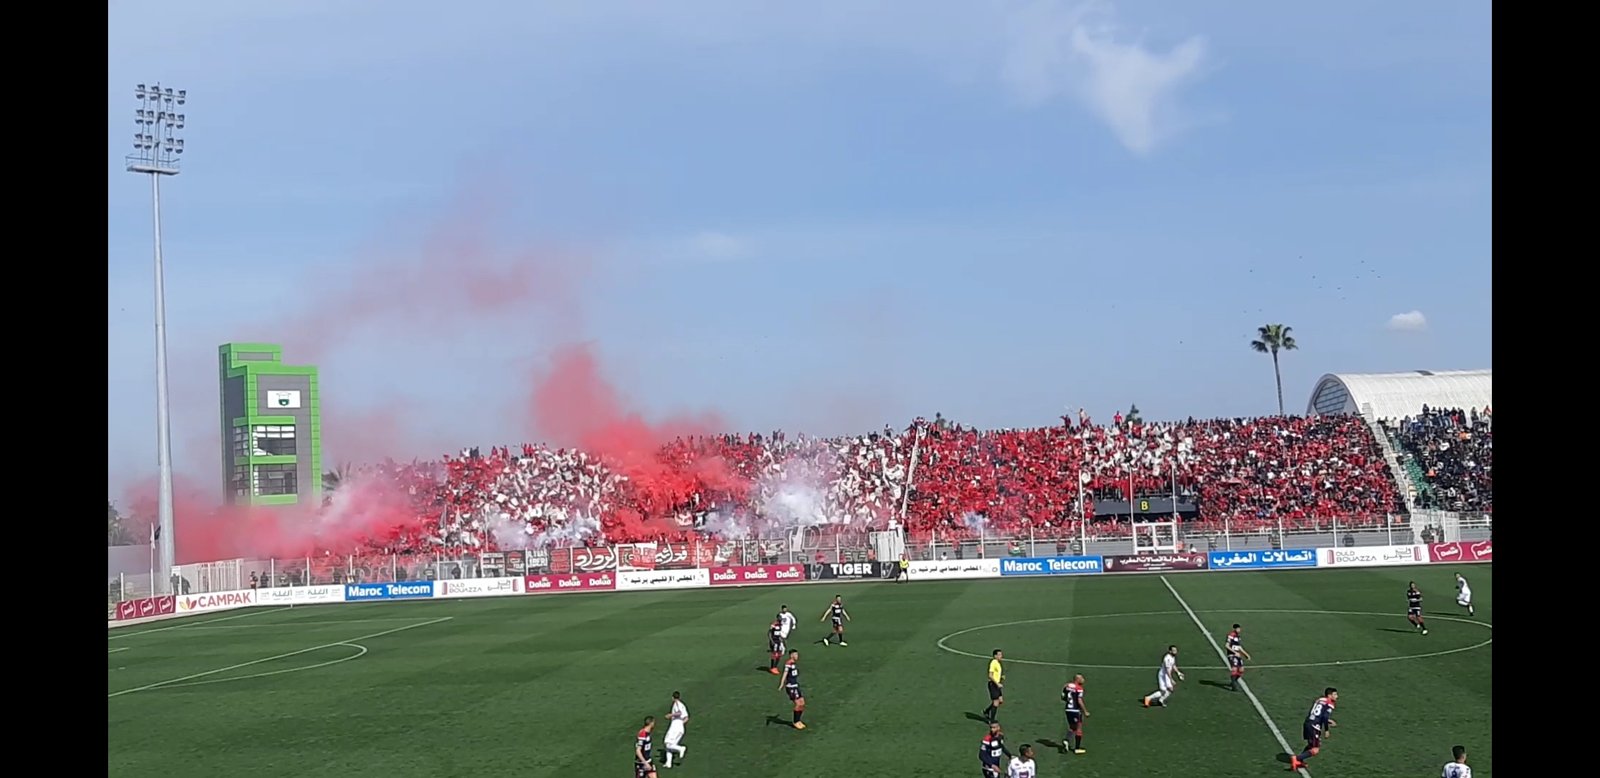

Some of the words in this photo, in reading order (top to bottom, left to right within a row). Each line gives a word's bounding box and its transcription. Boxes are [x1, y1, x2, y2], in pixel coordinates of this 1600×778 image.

[1141, 501, 1148, 510] B
[1213, 552, 1256, 566] المغرب
[1262, 550, 1312, 562] اتصالات
[830, 563, 873, 575] TIGER
[1004, 560, 1042, 572] Maroc
[1047, 559, 1098, 571] Telecom
[348, 585, 382, 597] Maroc
[386, 584, 430, 596] Telecom
[198, 592, 251, 607] CAMPAK
